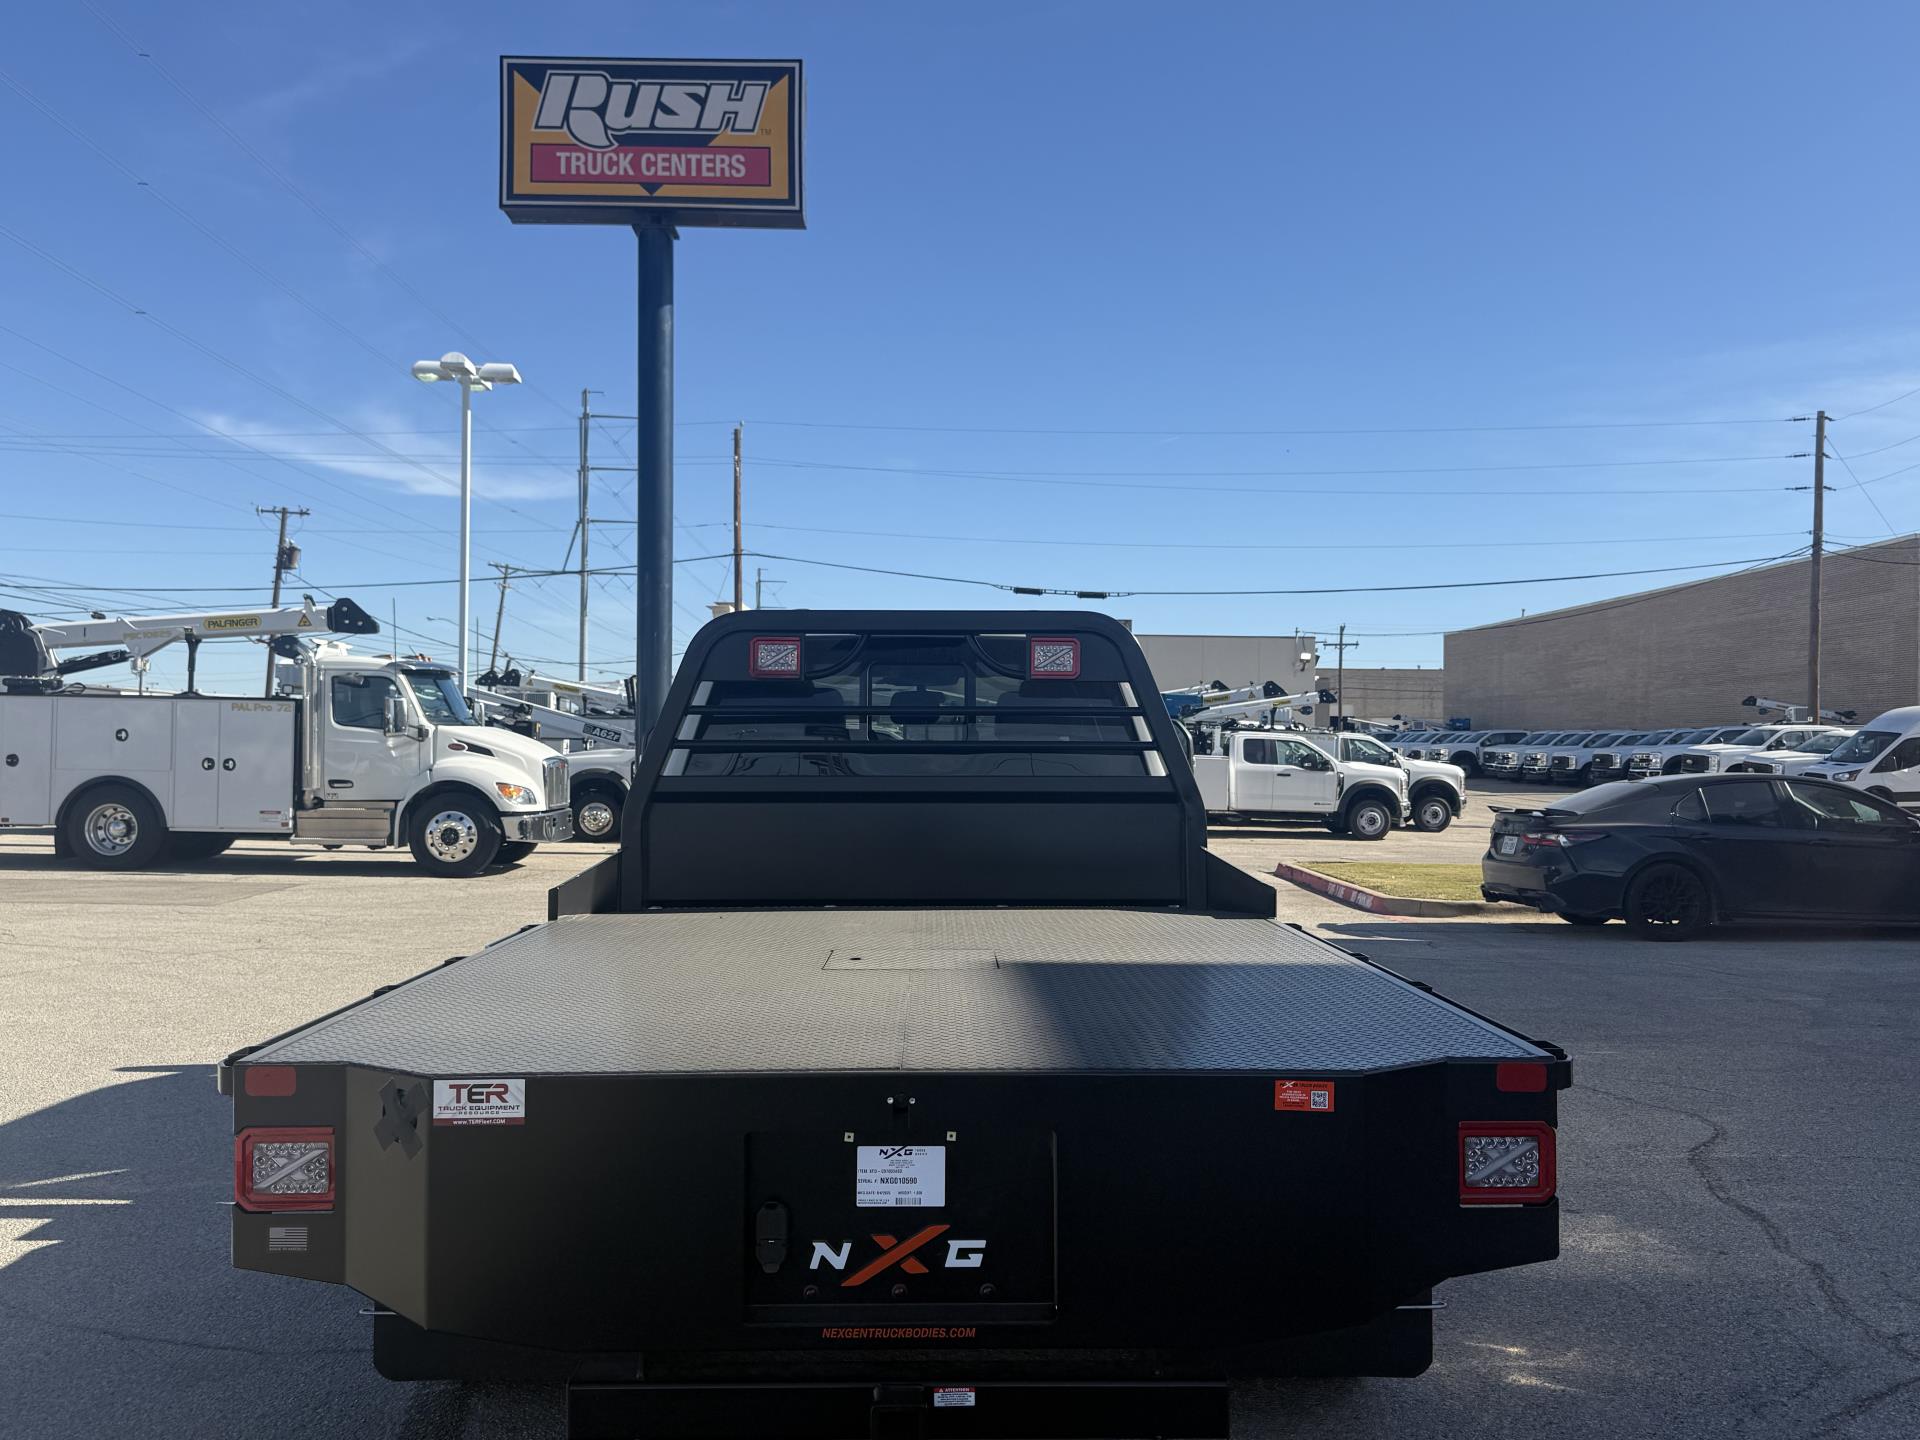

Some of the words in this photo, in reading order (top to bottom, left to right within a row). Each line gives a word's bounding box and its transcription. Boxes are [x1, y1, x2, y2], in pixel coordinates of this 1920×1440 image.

[556, 152, 634, 176] TRUCK
[641, 154, 746, 178] CENTERS
[448, 1083, 509, 1104] TER
[879, 1145, 914, 1159] NXG
[809, 1225, 987, 1287] NXG
[821, 1327, 977, 1339] NEXGENTRUCKBODIES.COM
